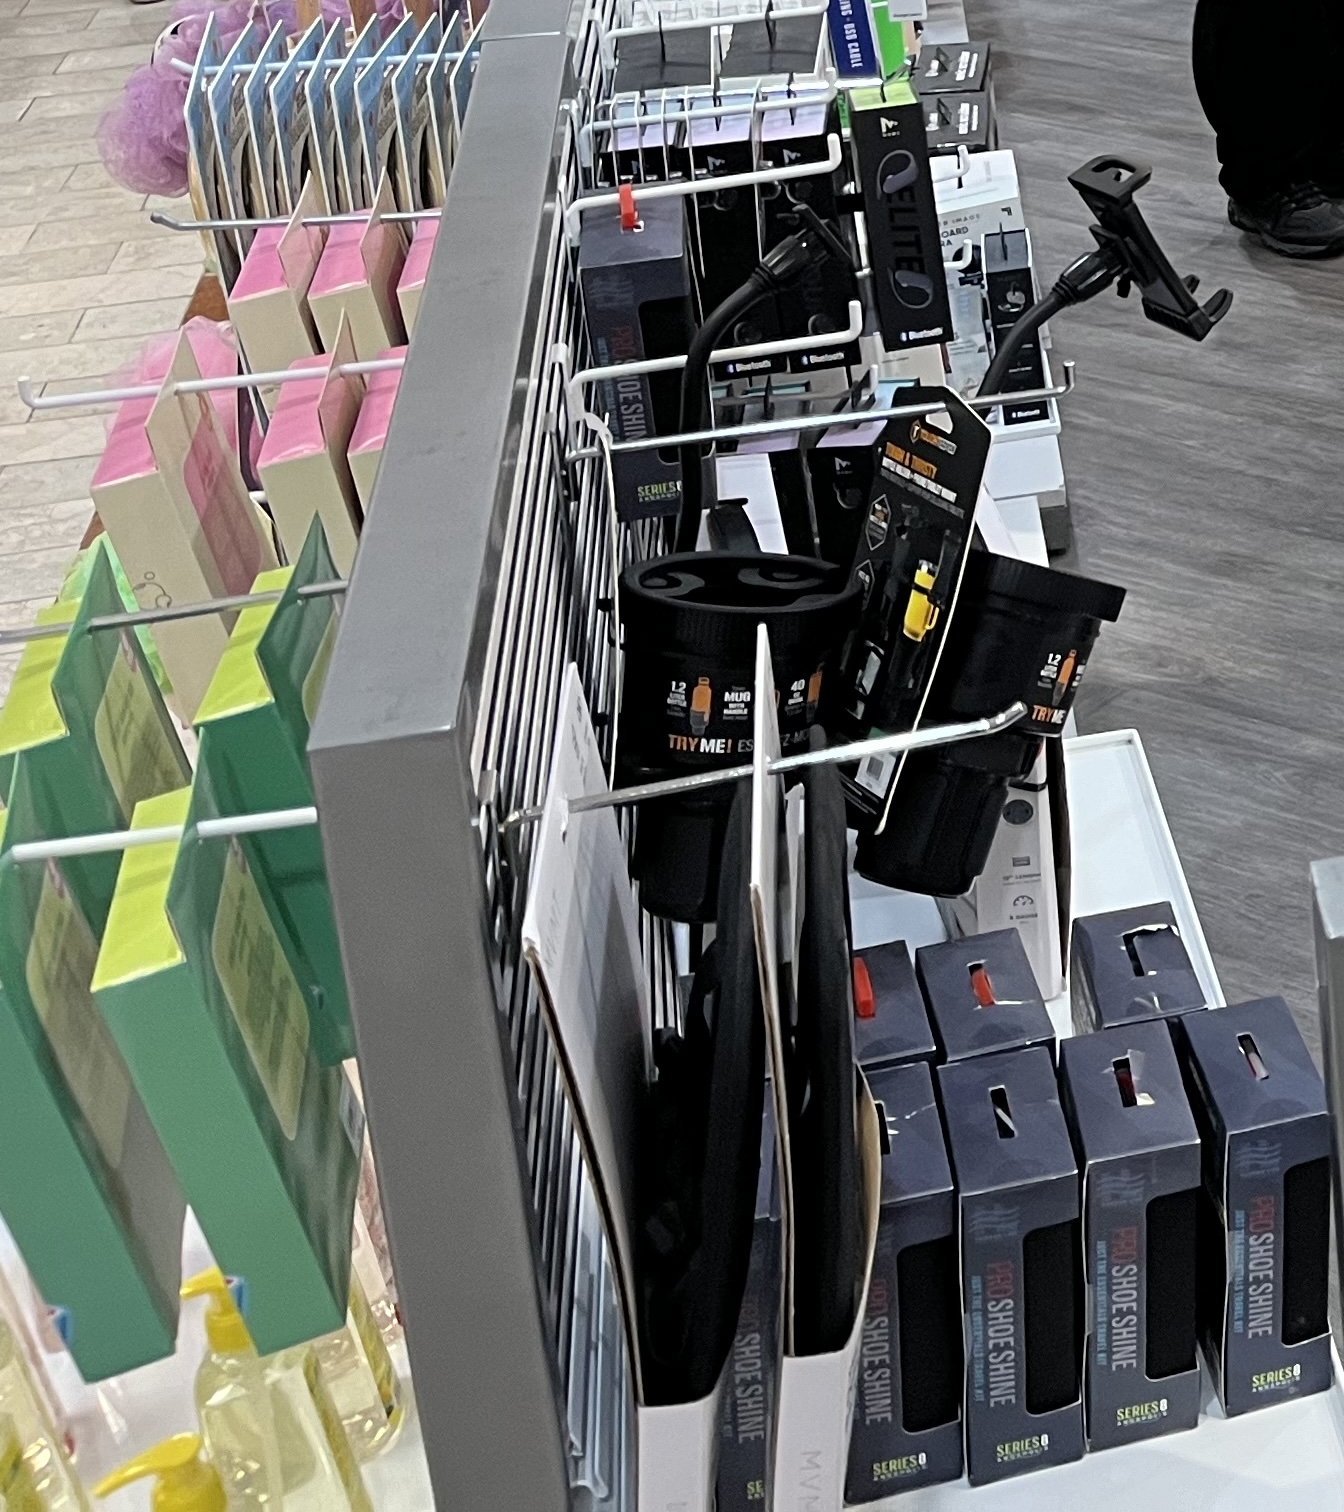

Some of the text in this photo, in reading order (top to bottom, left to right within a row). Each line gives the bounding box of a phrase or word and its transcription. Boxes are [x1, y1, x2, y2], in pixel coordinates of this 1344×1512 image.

[886, 189, 926, 275] ELITE
[724, 691, 751, 703] MUG
[790, 678, 806, 692] 40
[668, 733, 699, 752] TRY
[1248, 1233, 1275, 1282] SHOE
[1111, 1264, 1138, 1314] SHOE
[1247, 1283, 1274, 1340] SHINE
[863, 1316, 890, 1368] SHOE
[987, 1299, 1014, 1349] SHOE
[1112, 1315, 1138, 1372] SHINE
[734, 1332, 761, 1384] SHOE
[988, 1350, 1016, 1408] SHINE
[736, 1384, 764, 1444] SHINE
[864, 1368, 892, 1426] SHINE
